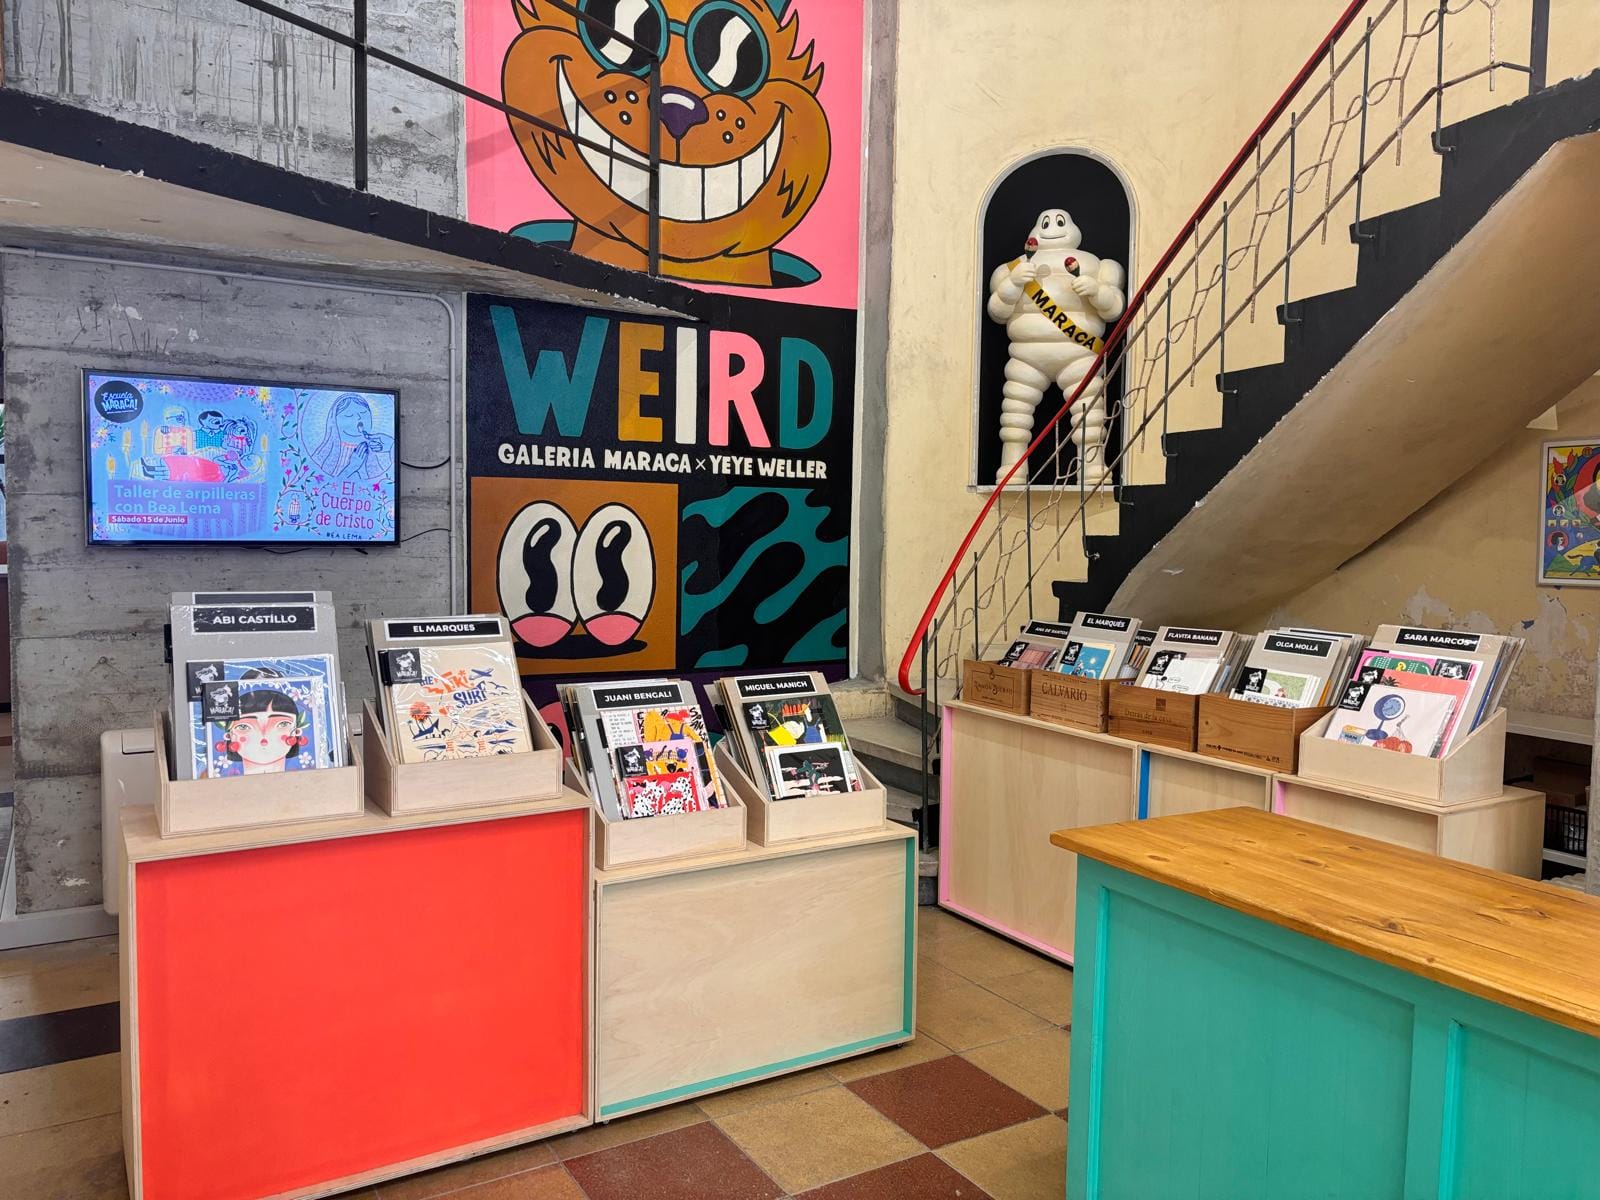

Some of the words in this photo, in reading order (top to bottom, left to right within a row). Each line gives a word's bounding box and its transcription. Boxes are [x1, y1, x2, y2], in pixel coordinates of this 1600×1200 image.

[1031, 288, 1096, 350] MARACA
[490, 305, 833, 449] WEIRD
[498, 443, 595, 468] GALERIA
[604, 449, 692, 473] MARACA
[709, 455, 753, 476] YEYE
[757, 457, 827, 479] WELLER
[114, 485, 158, 498] Taller
[162, 485, 181, 499] de
[185, 486, 256, 501] arpilleras
[342, 481, 355, 495] El
[114, 502, 142, 513] con
[148, 501, 176, 513] Bea
[180, 502, 221, 514] Lema
[322, 492, 371, 514] Cuerpo
[111, 515, 142, 523] Sábado
[164, 516, 185, 524] Junio
[315, 510, 331, 526] de
[335, 512, 374, 529] Cristo
[212, 615, 236, 625] ABI
[238, 613, 297, 624] CASTILLO
[413, 625, 425, 633] EL
[426, 624, 476, 633] MARQUES
[1167, 632, 1192, 640] FLAVITA
[1191, 634, 1218, 642] BANANA
[1403, 633, 1428, 641] SARA
[1275, 641, 1295, 649] OLGA
[744, 683, 776, 692] MIGUEL
[776, 681, 808, 689] MANICH
[1041, 682, 1088, 702] CALVARIO
[604, 693, 632, 702] JUANI
[634, 691, 673, 700] BENGALI
